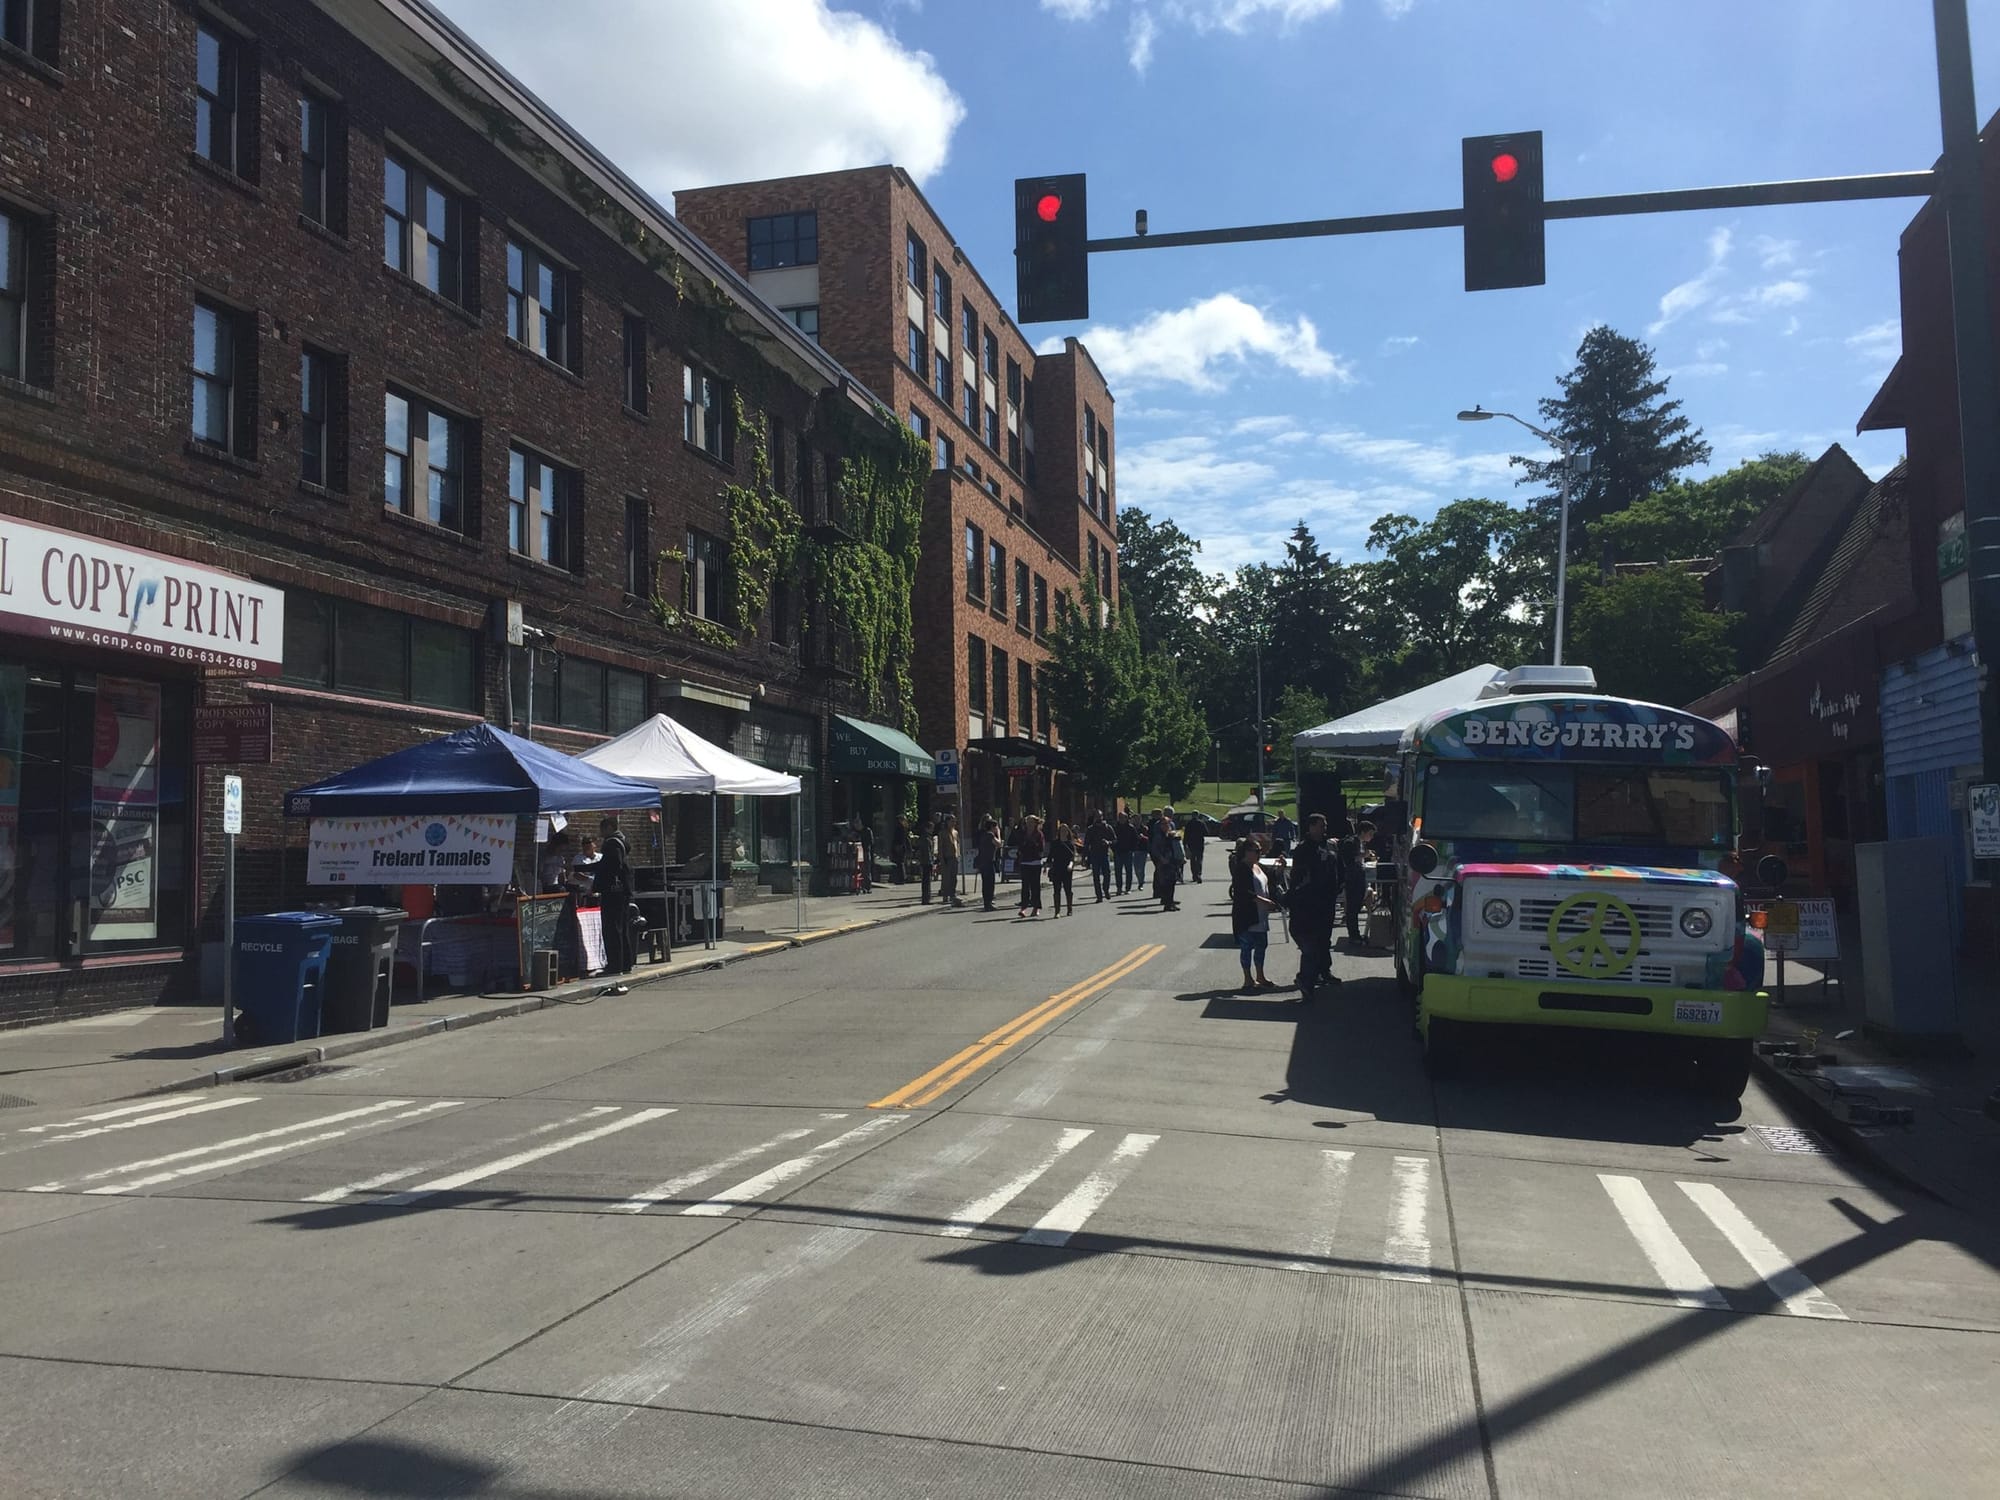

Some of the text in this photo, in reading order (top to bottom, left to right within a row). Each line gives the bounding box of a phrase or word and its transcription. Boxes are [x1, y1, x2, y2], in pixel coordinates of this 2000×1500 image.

[41, 547, 135, 618] COPY
[163, 576, 263, 645] PRINT
[50, 625, 258, 671] www.qcnp.com 206-634-2689
[195, 706, 267, 719] PROFESSIONAL
[196, 718, 266, 729] COPY PRINT
[835, 732, 851, 742] WE
[849, 746, 868, 756] BUY
[867, 760, 897, 769] BOOKS
[943, 765, 951, 776] 2
[372, 849, 492, 867] Frelard Tamales
[117, 870, 145, 888] PSC
[240, 942, 283, 953] RECYCLE
